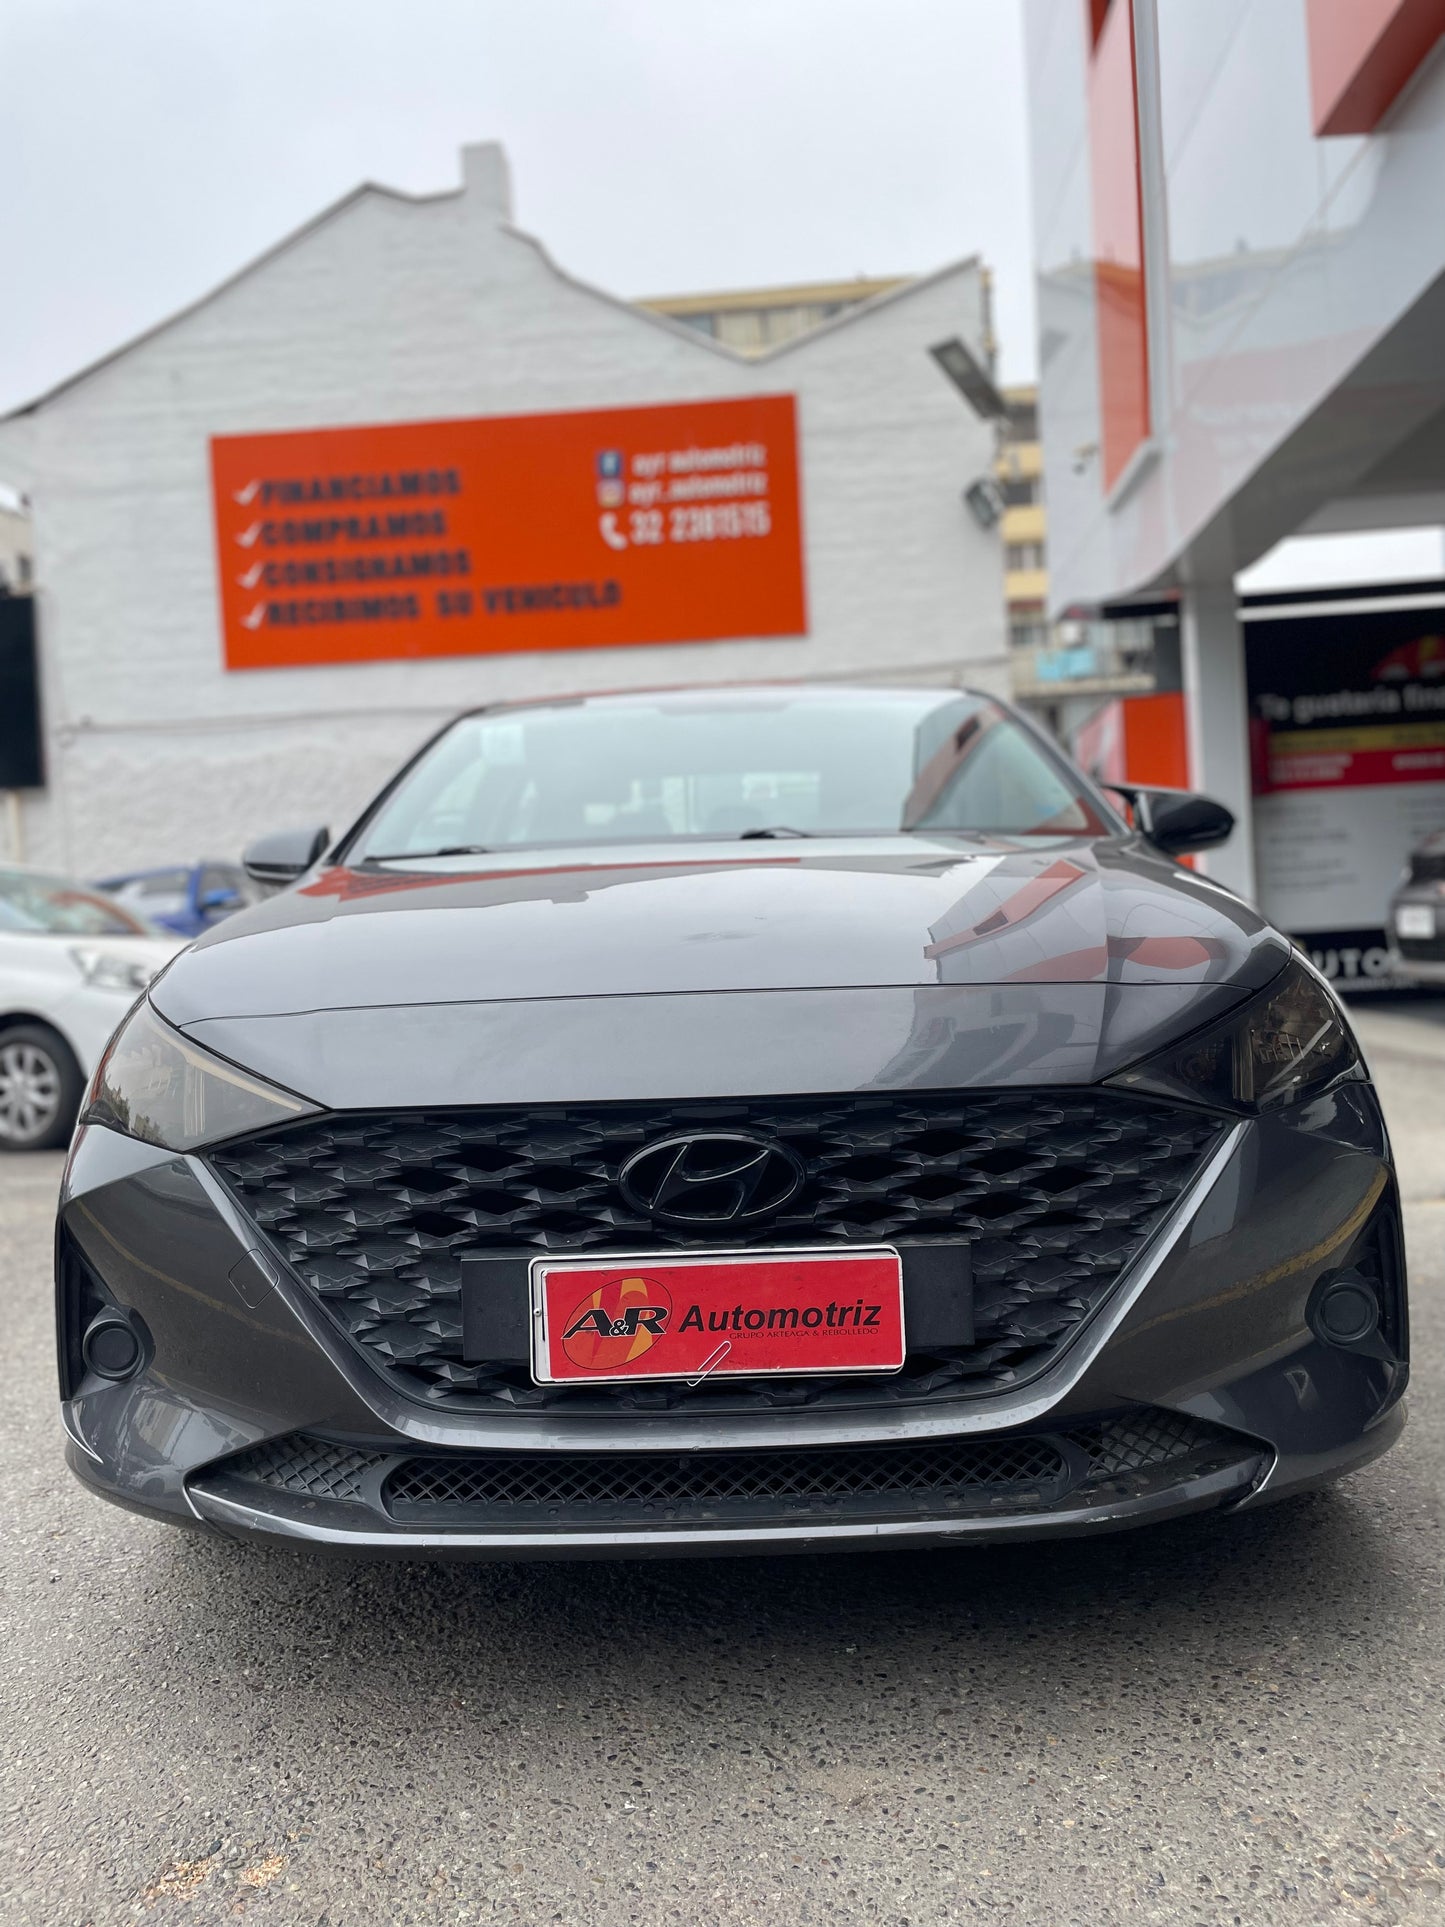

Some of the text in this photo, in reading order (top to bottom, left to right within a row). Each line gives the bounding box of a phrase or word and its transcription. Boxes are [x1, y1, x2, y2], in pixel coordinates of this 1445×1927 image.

[261, 469, 461, 505] FINANCIAMOS
[262, 510, 447, 546] COMPRAMOS
[630, 510, 663, 544] 32
[264, 549, 470, 587] CONSIGNAMOS
[267, 594, 420, 626] RECIBIMOS
[436, 589, 473, 617] SU
[560, 1299, 882, 1340] A&R Automotriz
[729, 1328, 879, 1340] GRUPO ARTEAGA & REBOLLEDO
